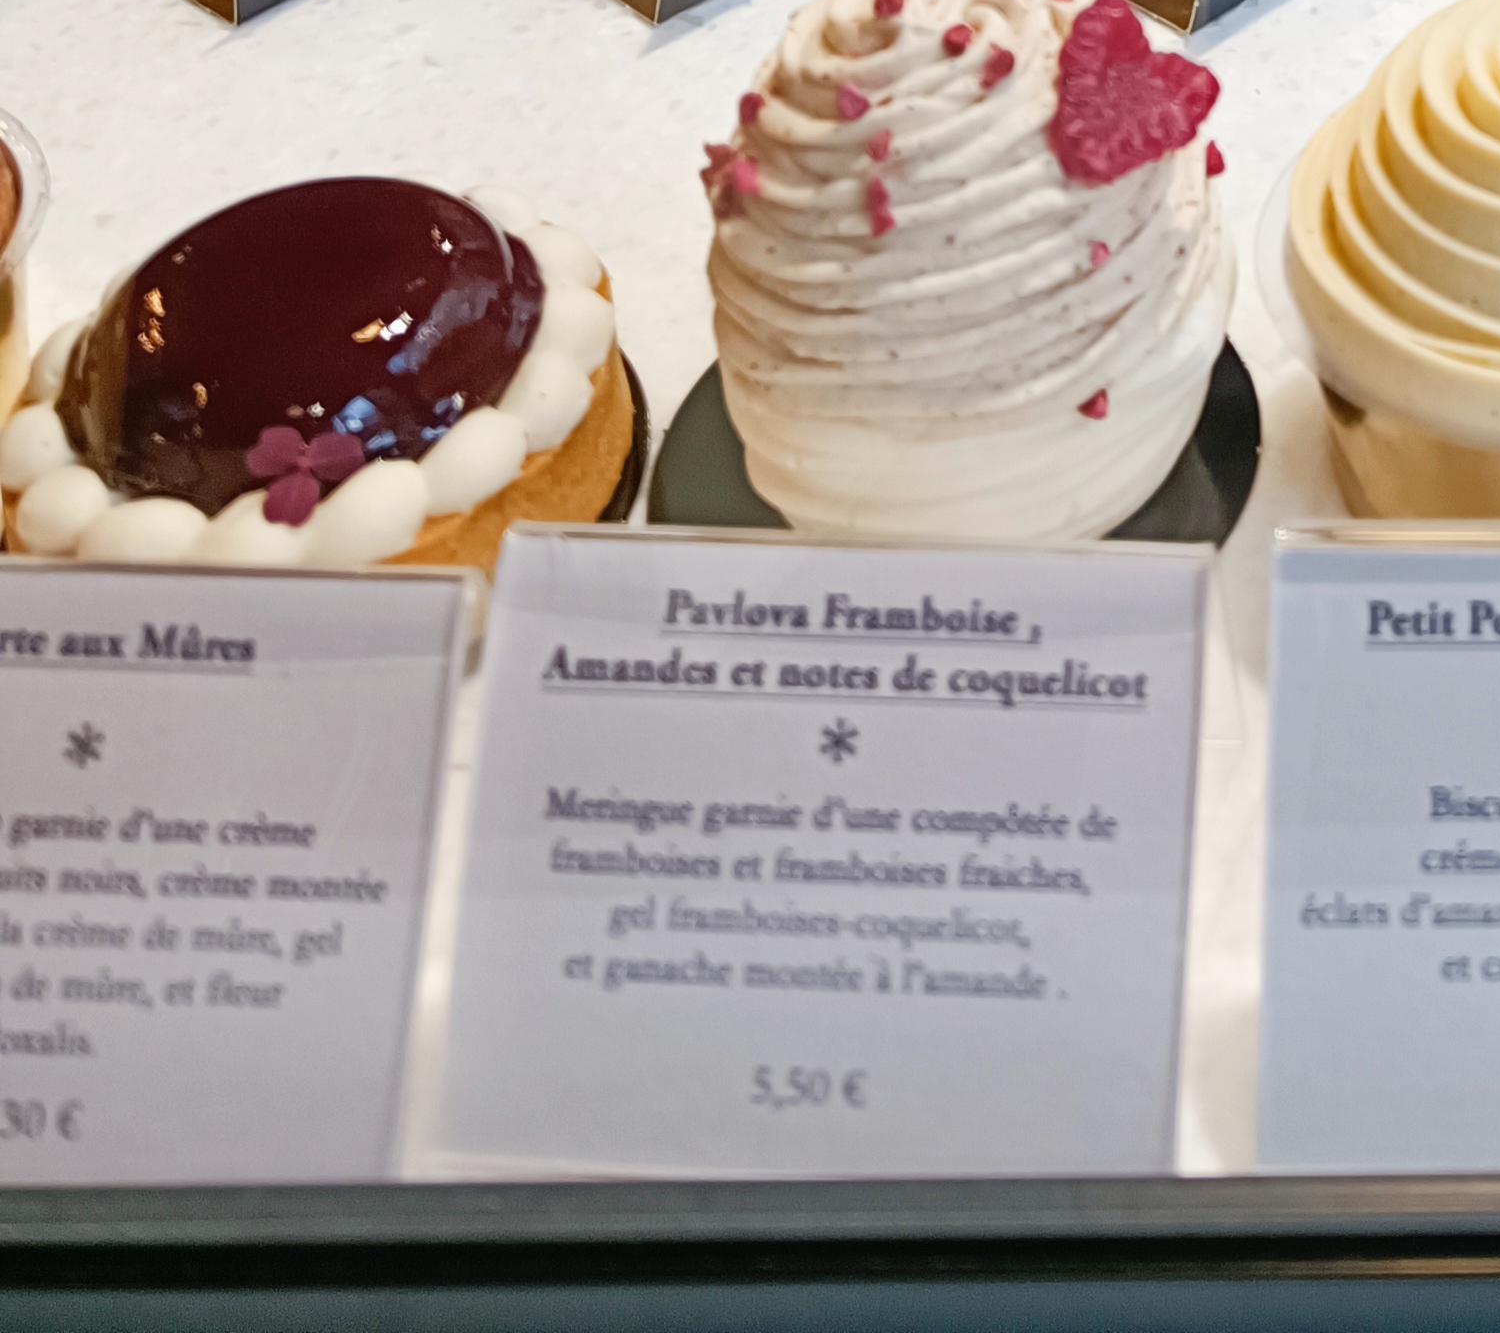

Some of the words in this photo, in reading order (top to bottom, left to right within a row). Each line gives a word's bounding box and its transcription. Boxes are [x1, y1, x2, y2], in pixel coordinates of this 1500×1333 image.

[663, 588, 810, 629] Pavlova
[822, 593, 1019, 635] Framboise
[1367, 598, 1455, 637] Petit
[57, 631, 126, 658] aux
[137, 621, 256, 662] Mûres
[541, 644, 718, 685] Amandes
[730, 659, 767, 687] et
[778, 662, 880, 690] notes
[891, 653, 935, 692] de
[947, 658, 1149, 707] coquelicot
[544, 786, 694, 834] Meringue
[703, 793, 802, 836] garnie
[1076, 802, 1118, 841] de
[548, 838, 720, 878] framboises
[731, 855, 762, 881] et
[773, 845, 947, 889] framboises
[142, 915, 180, 951] de
[608, 893, 656, 938] gel
[1302, 891, 1389, 931] éclats
[564, 953, 594, 981] et
[602, 949, 733, 991] ganache
[743, 955, 863, 994] montée
[868, 951, 892, 994] à
[1441, 955, 1471, 983] et
[749, 1064, 831, 1113] 5,50
[840, 1067, 868, 1110] €
[55, 1098, 86, 1142] €
